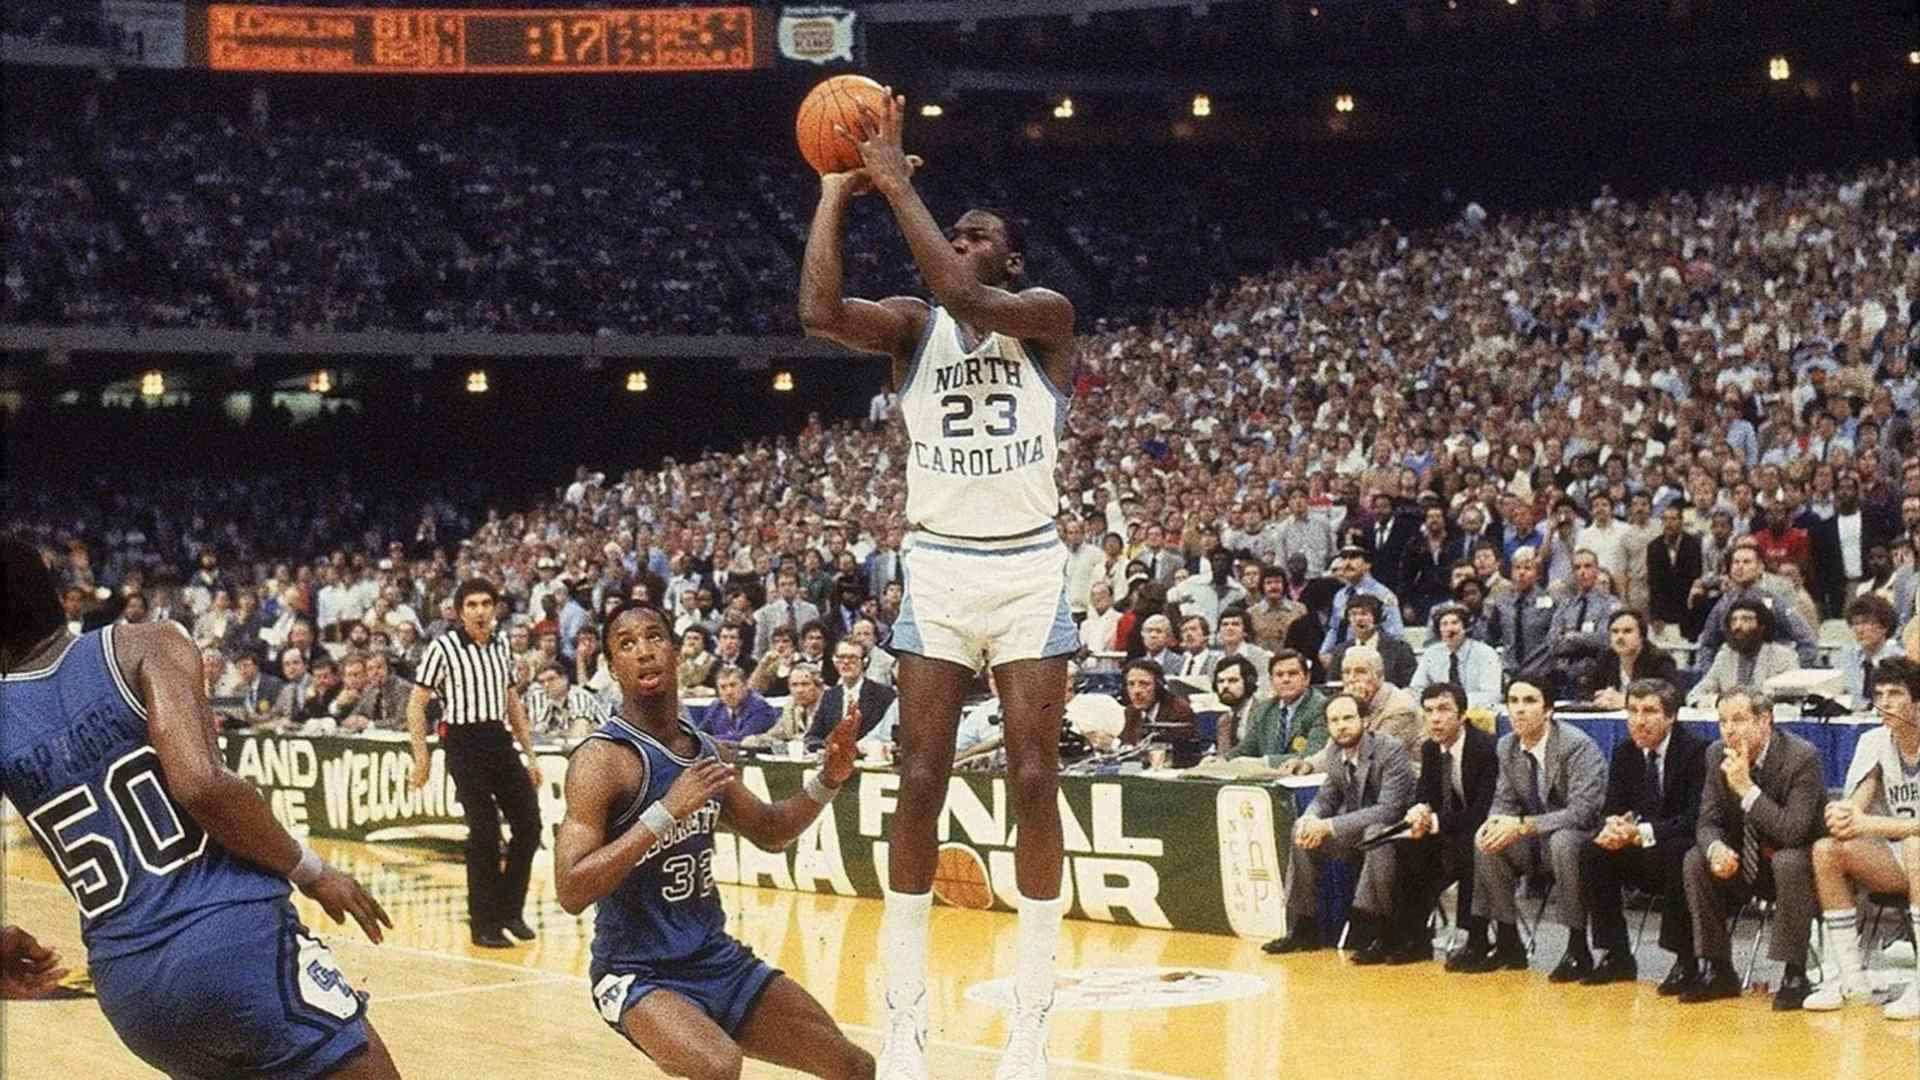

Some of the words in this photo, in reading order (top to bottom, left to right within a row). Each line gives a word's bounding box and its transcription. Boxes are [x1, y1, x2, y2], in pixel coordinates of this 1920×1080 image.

[934, 356, 1023, 394] NORTH
[941, 393, 1018, 438] 23
[914, 434, 1045, 477] CAROLINA
[238, 737, 318, 788] AND
[27, 743, 208, 919] 50
[858, 770, 1164, 857] FNAL
